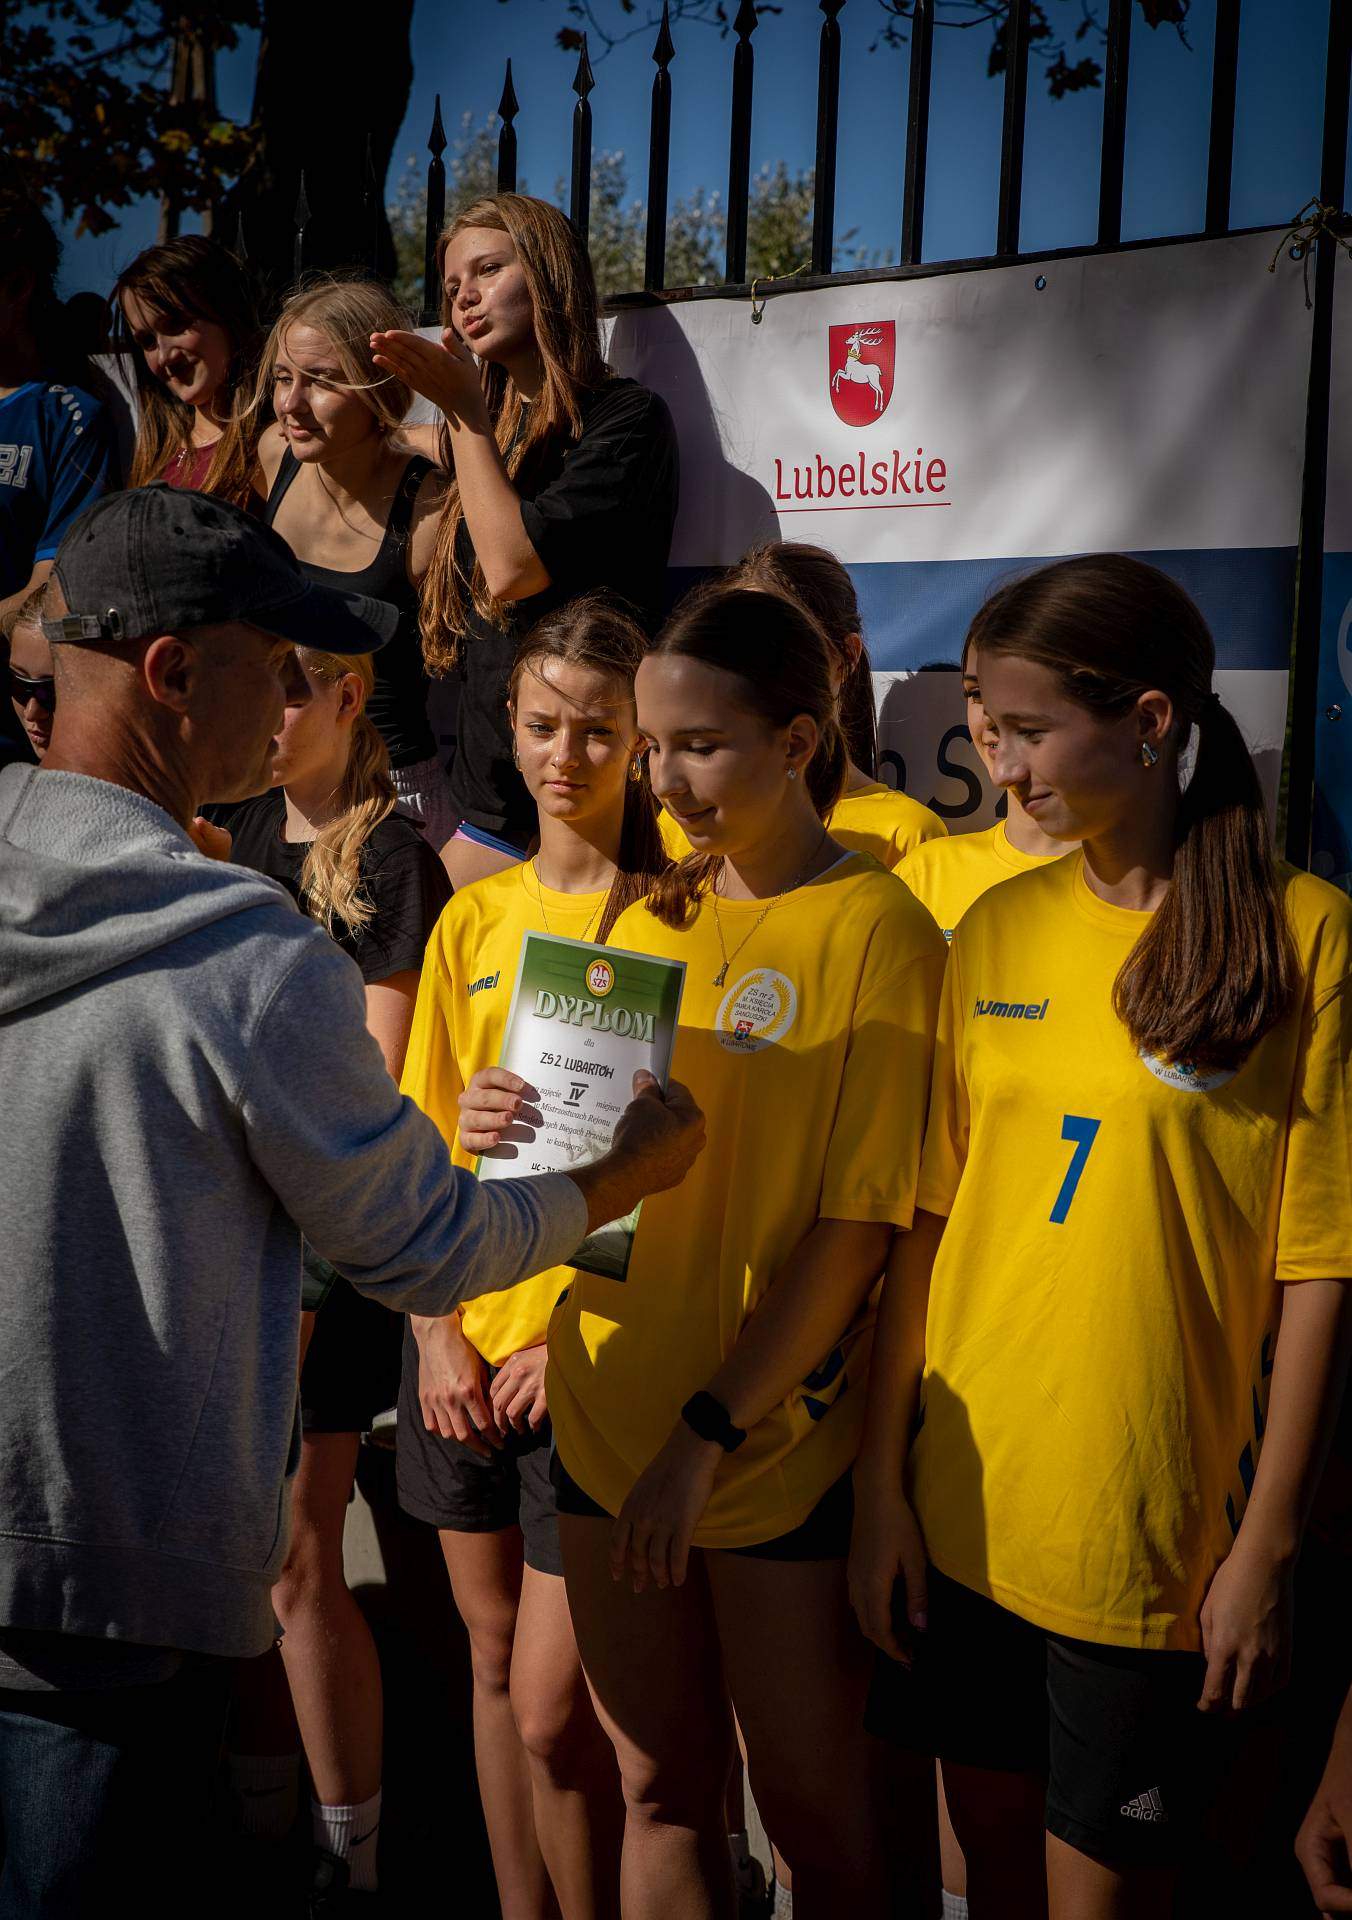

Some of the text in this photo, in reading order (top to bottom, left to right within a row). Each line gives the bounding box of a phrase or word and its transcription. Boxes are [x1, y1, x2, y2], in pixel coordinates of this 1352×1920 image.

[775, 447, 948, 499] Lubelskie
[592, 978, 608, 988] SZS
[533, 989, 656, 1043] DYPLOM
[583, 1038, 595, 1048] dla
[1154, 1067, 1163, 1076] W
[596, 1101, 621, 1113] miejsca
[539, 1103, 587, 1121] Mistrzostwach
[588, 1114, 611, 1127] Rejonu
[558, 1123, 585, 1138] Biegach
[553, 1137, 584, 1152] kategorii
[1049, 1114, 1102, 1224] 7
[1120, 1805, 1168, 1822] adida
